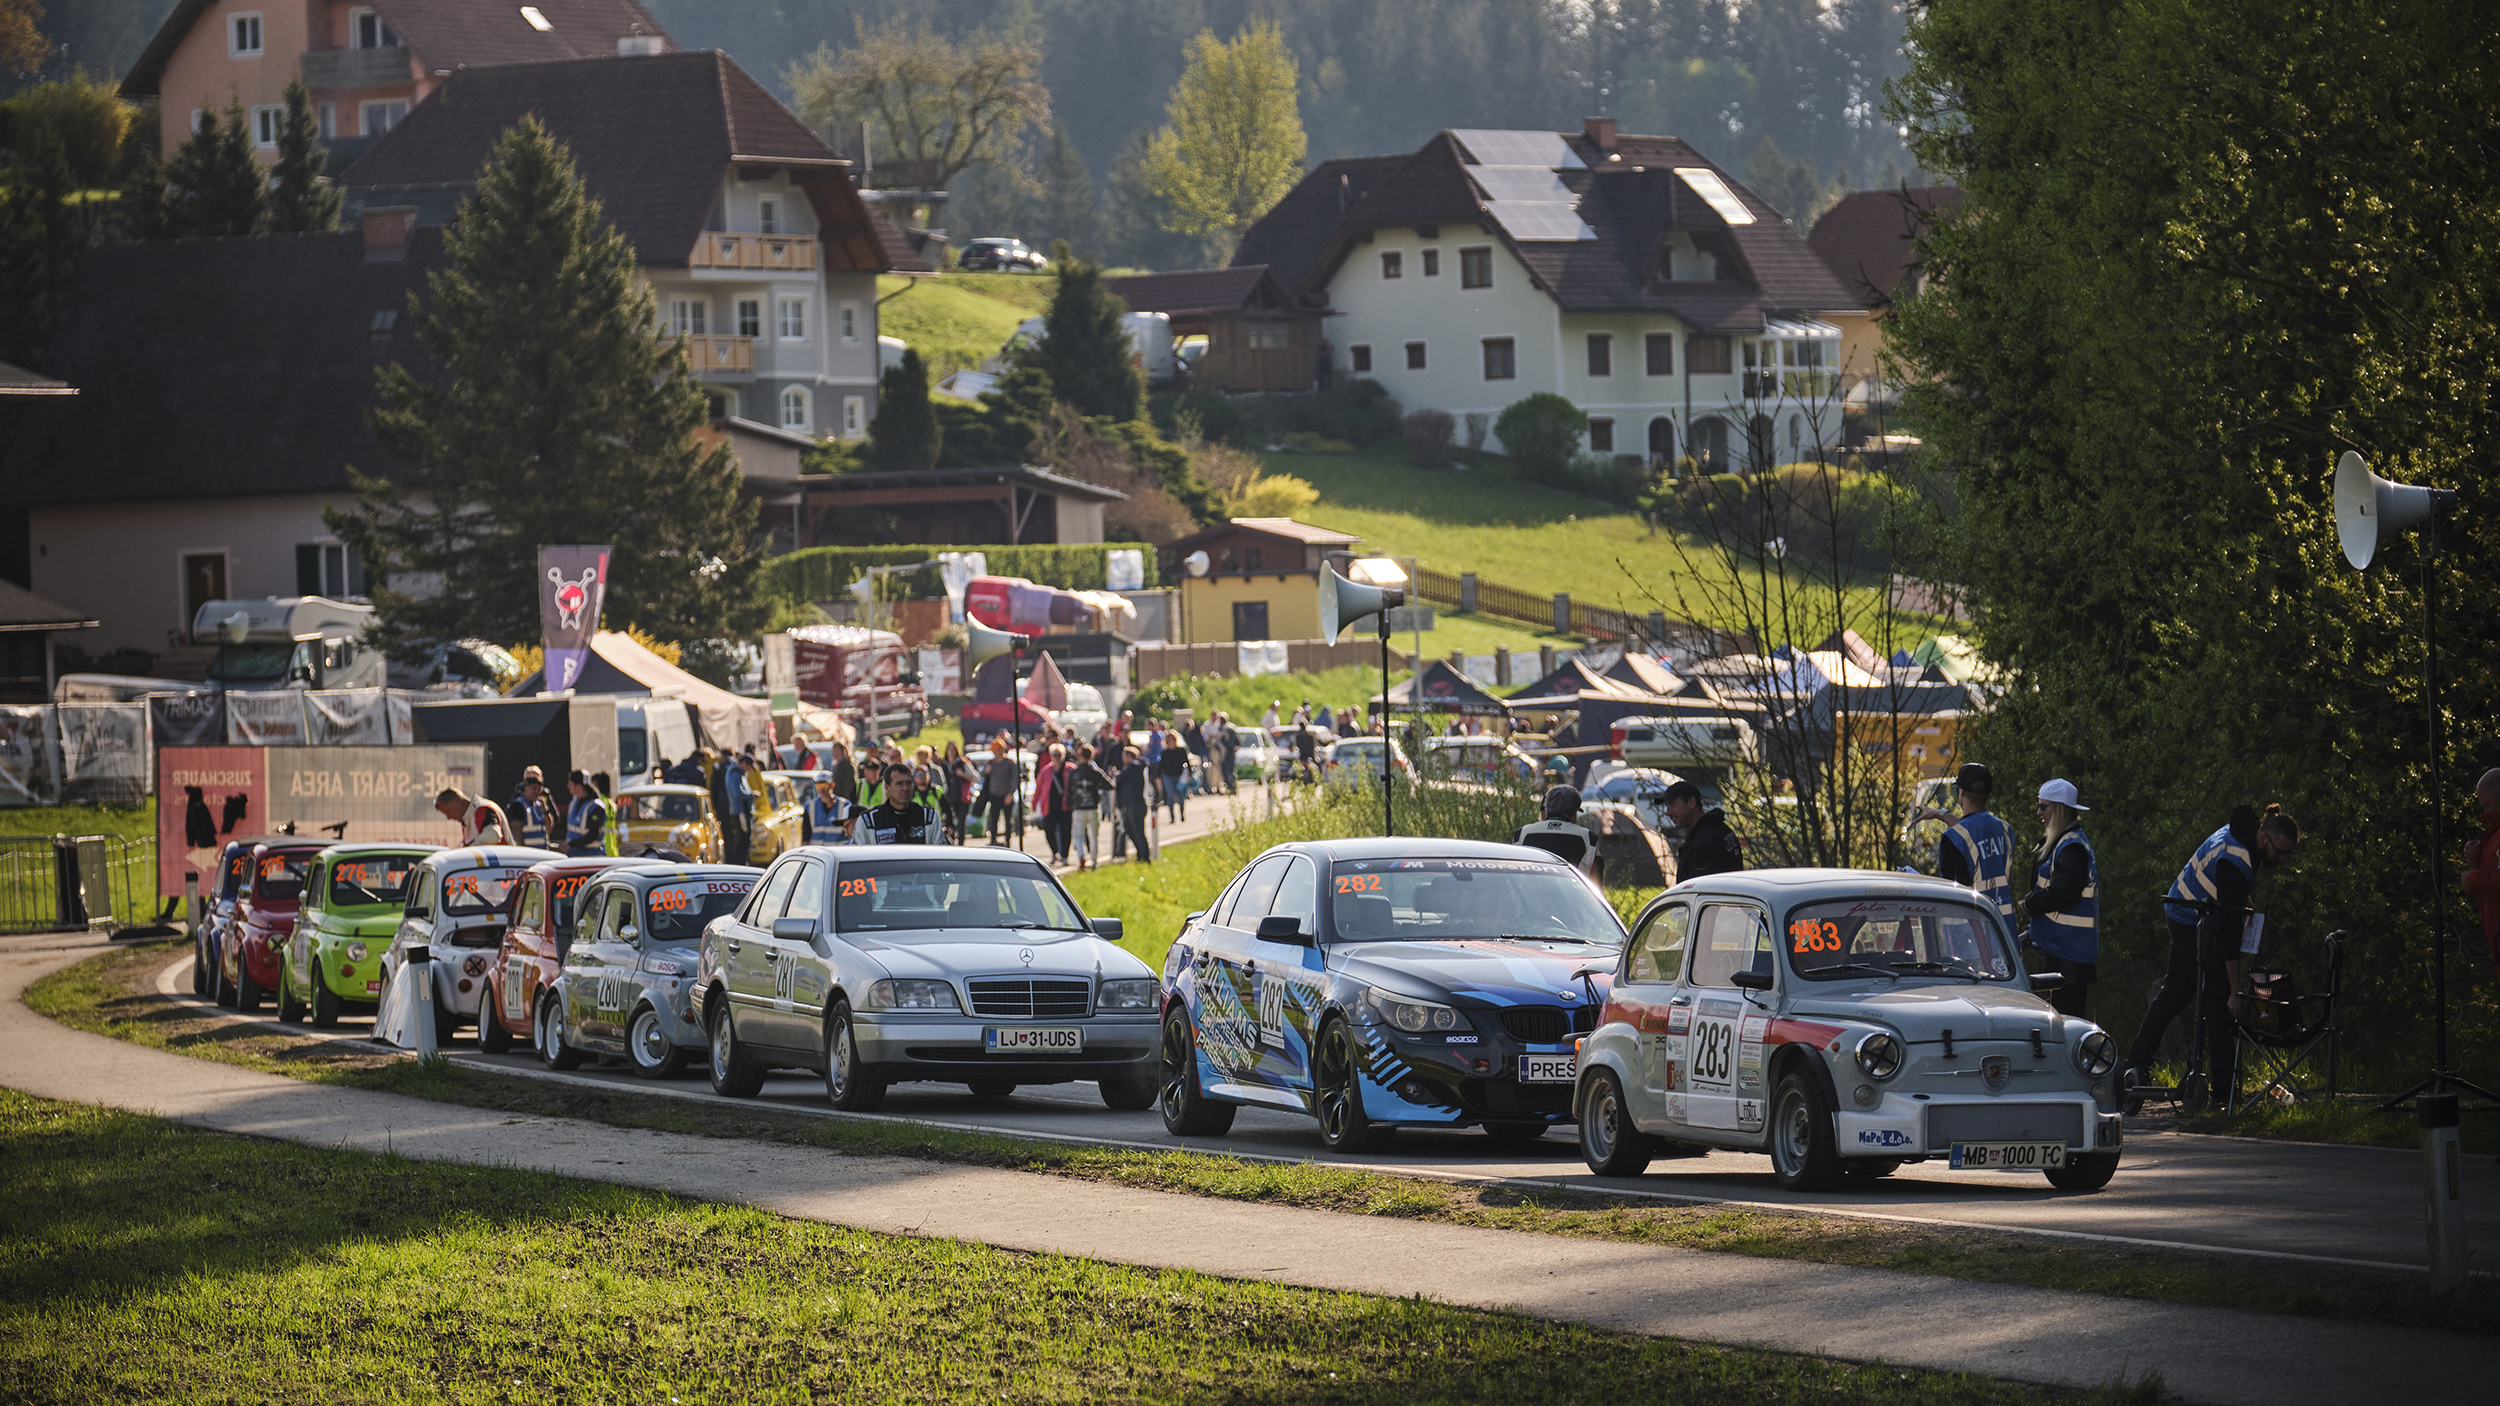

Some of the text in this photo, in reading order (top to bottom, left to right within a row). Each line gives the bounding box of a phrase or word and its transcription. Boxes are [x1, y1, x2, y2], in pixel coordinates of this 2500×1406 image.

[163, 698, 215, 717] TRIMAS
[260, 855, 285, 877] 275
[335, 863, 366, 882] 276
[1445, 860, 1561, 874] Motorsport
[445, 875, 478, 896] 278
[707, 882, 756, 894] BOSC
[839, 877, 878, 897] 281
[1335, 874, 1383, 894] 282
[650, 889, 686, 912] 280
[1846, 901, 1887, 917] foto
[1789, 921, 1842, 953] 283
[657, 961, 679, 973] BOSCH
[776, 955, 796, 1000] 281
[599, 968, 622, 1009] 280
[1262, 979, 1283, 1033] 282
[1000, 1031, 1077, 1047] LJ 31-UDS
[1445, 1035, 1479, 1044] sparco
[1694, 1020, 1732, 1080] 283
[1964, 1146, 1988, 1166] MB
[2002, 1145, 2036, 1165] 1000
